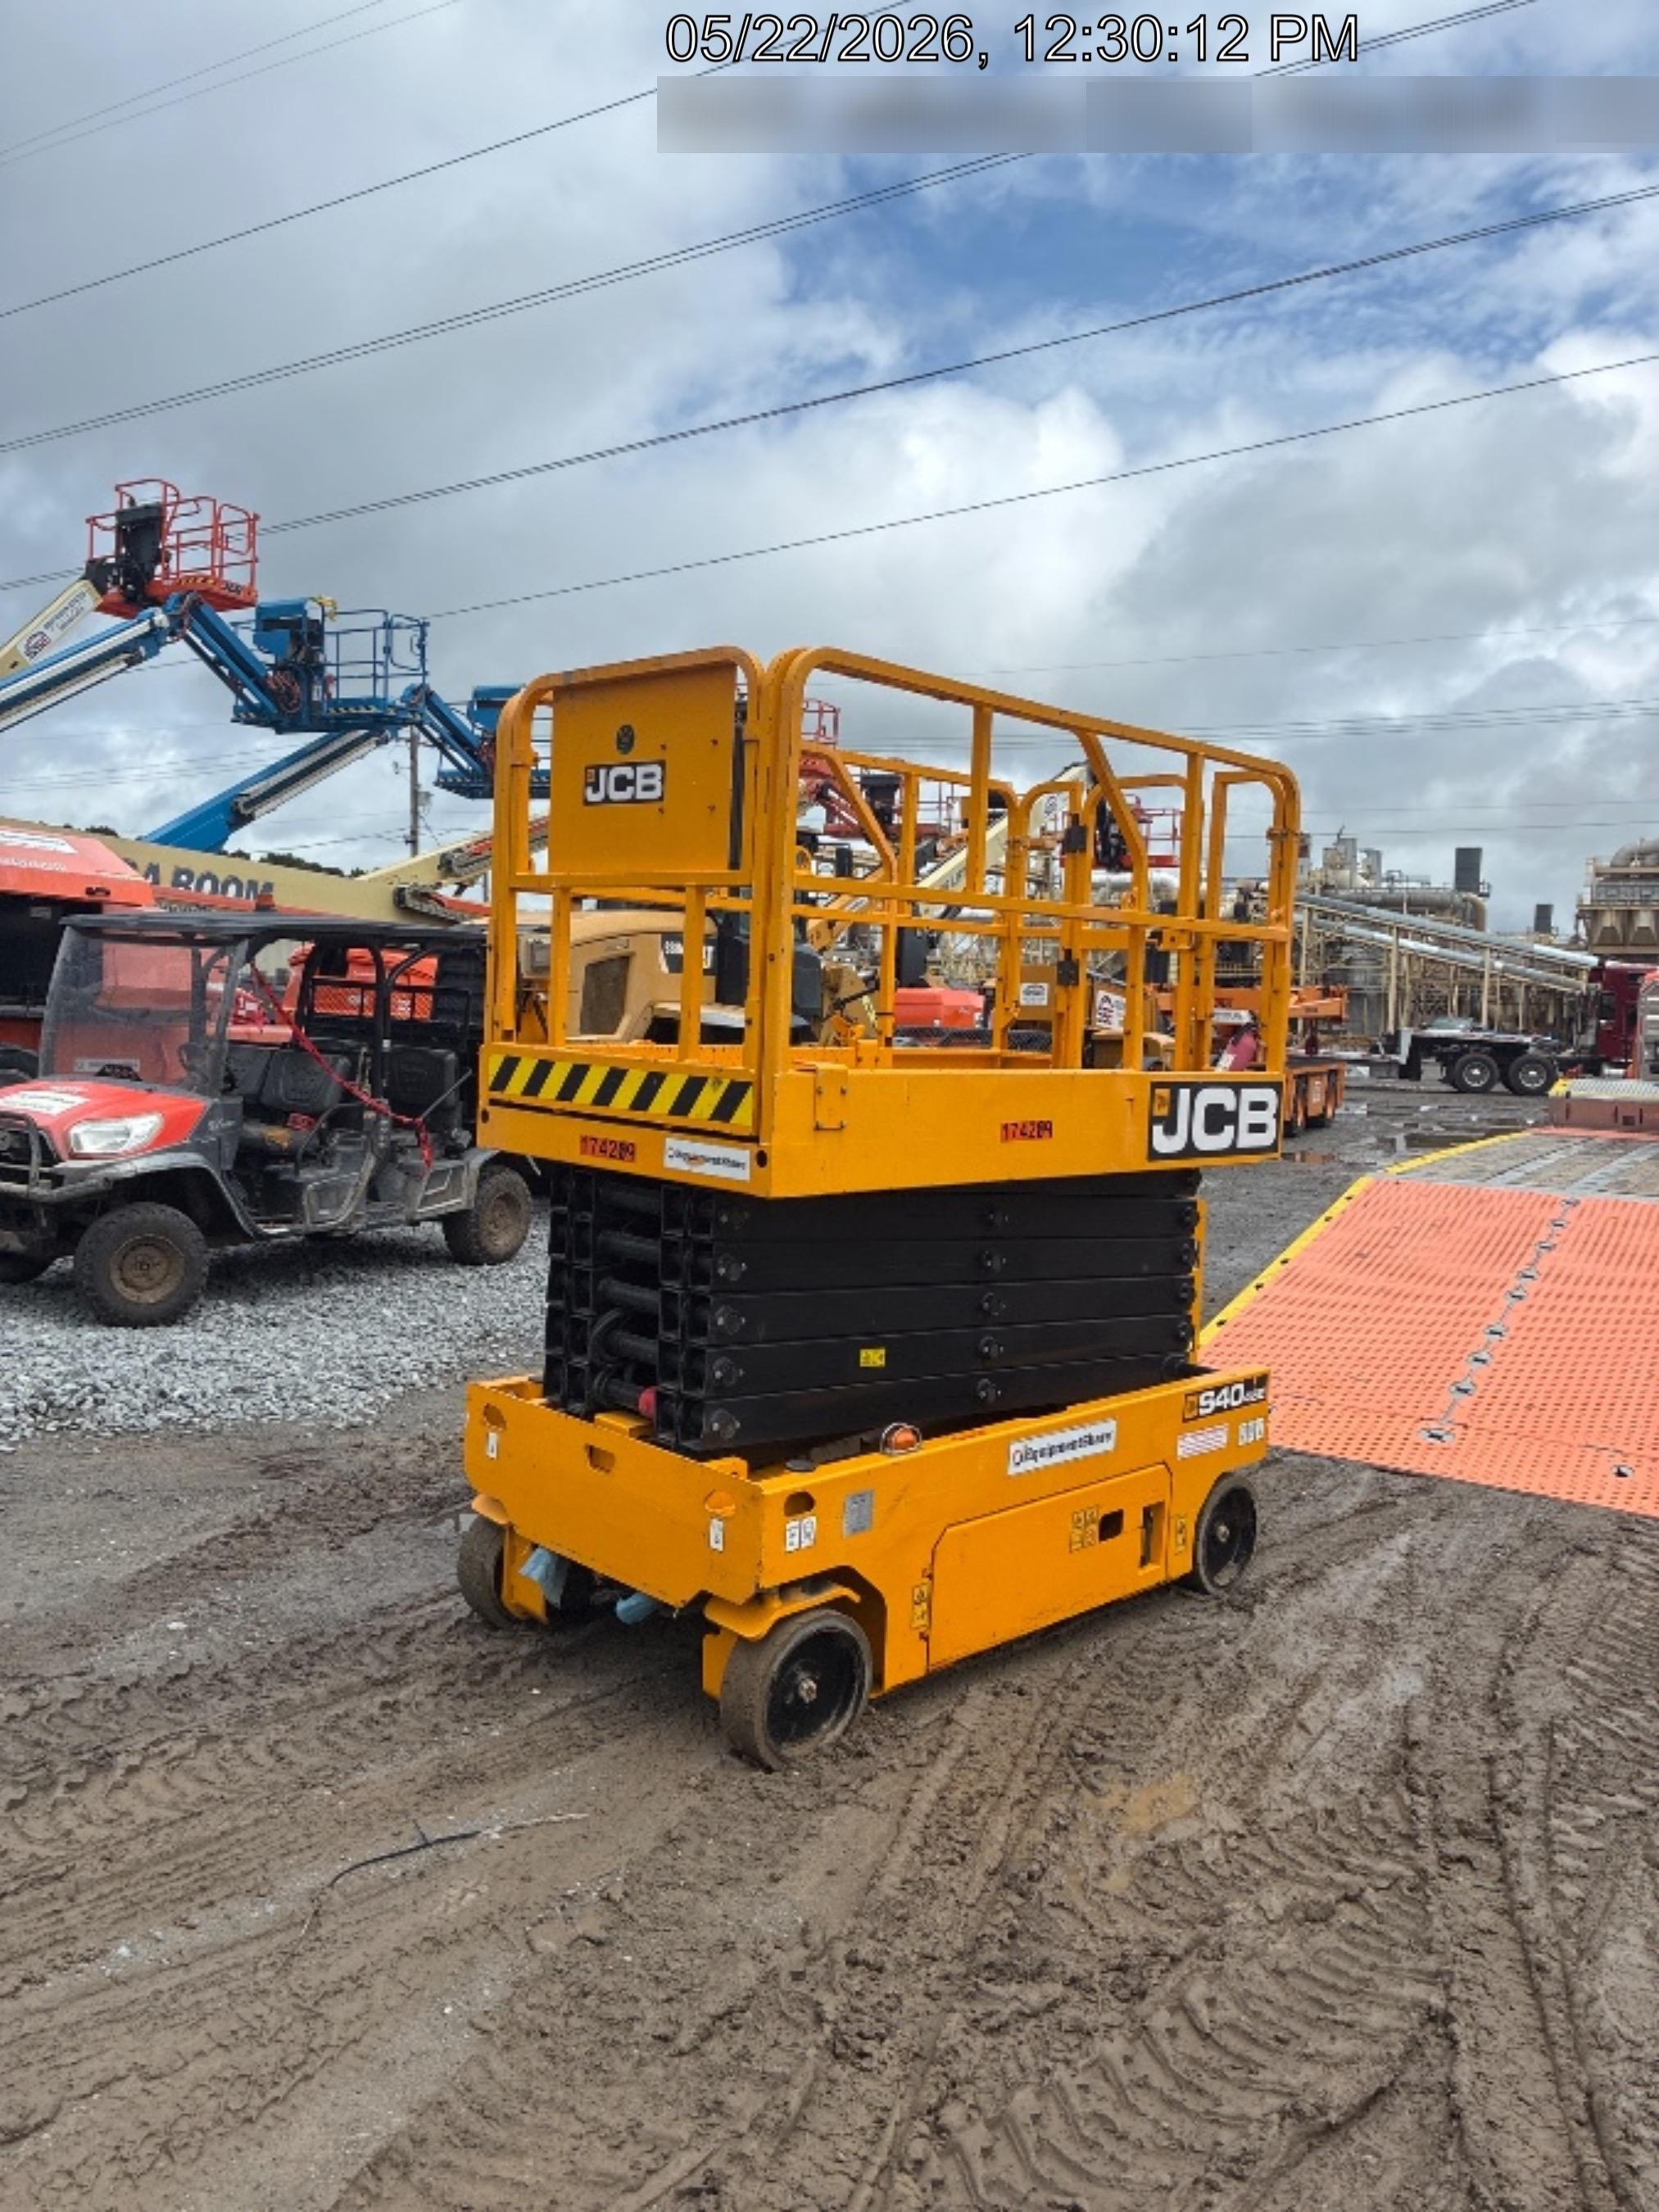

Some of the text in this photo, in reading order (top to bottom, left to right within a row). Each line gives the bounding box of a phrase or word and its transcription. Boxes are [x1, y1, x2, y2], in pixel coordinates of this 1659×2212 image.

[586, 763, 663, 802] JCB
[171, 865, 274, 900] BOOM
[1152, 1087, 1279, 1154] JCB
